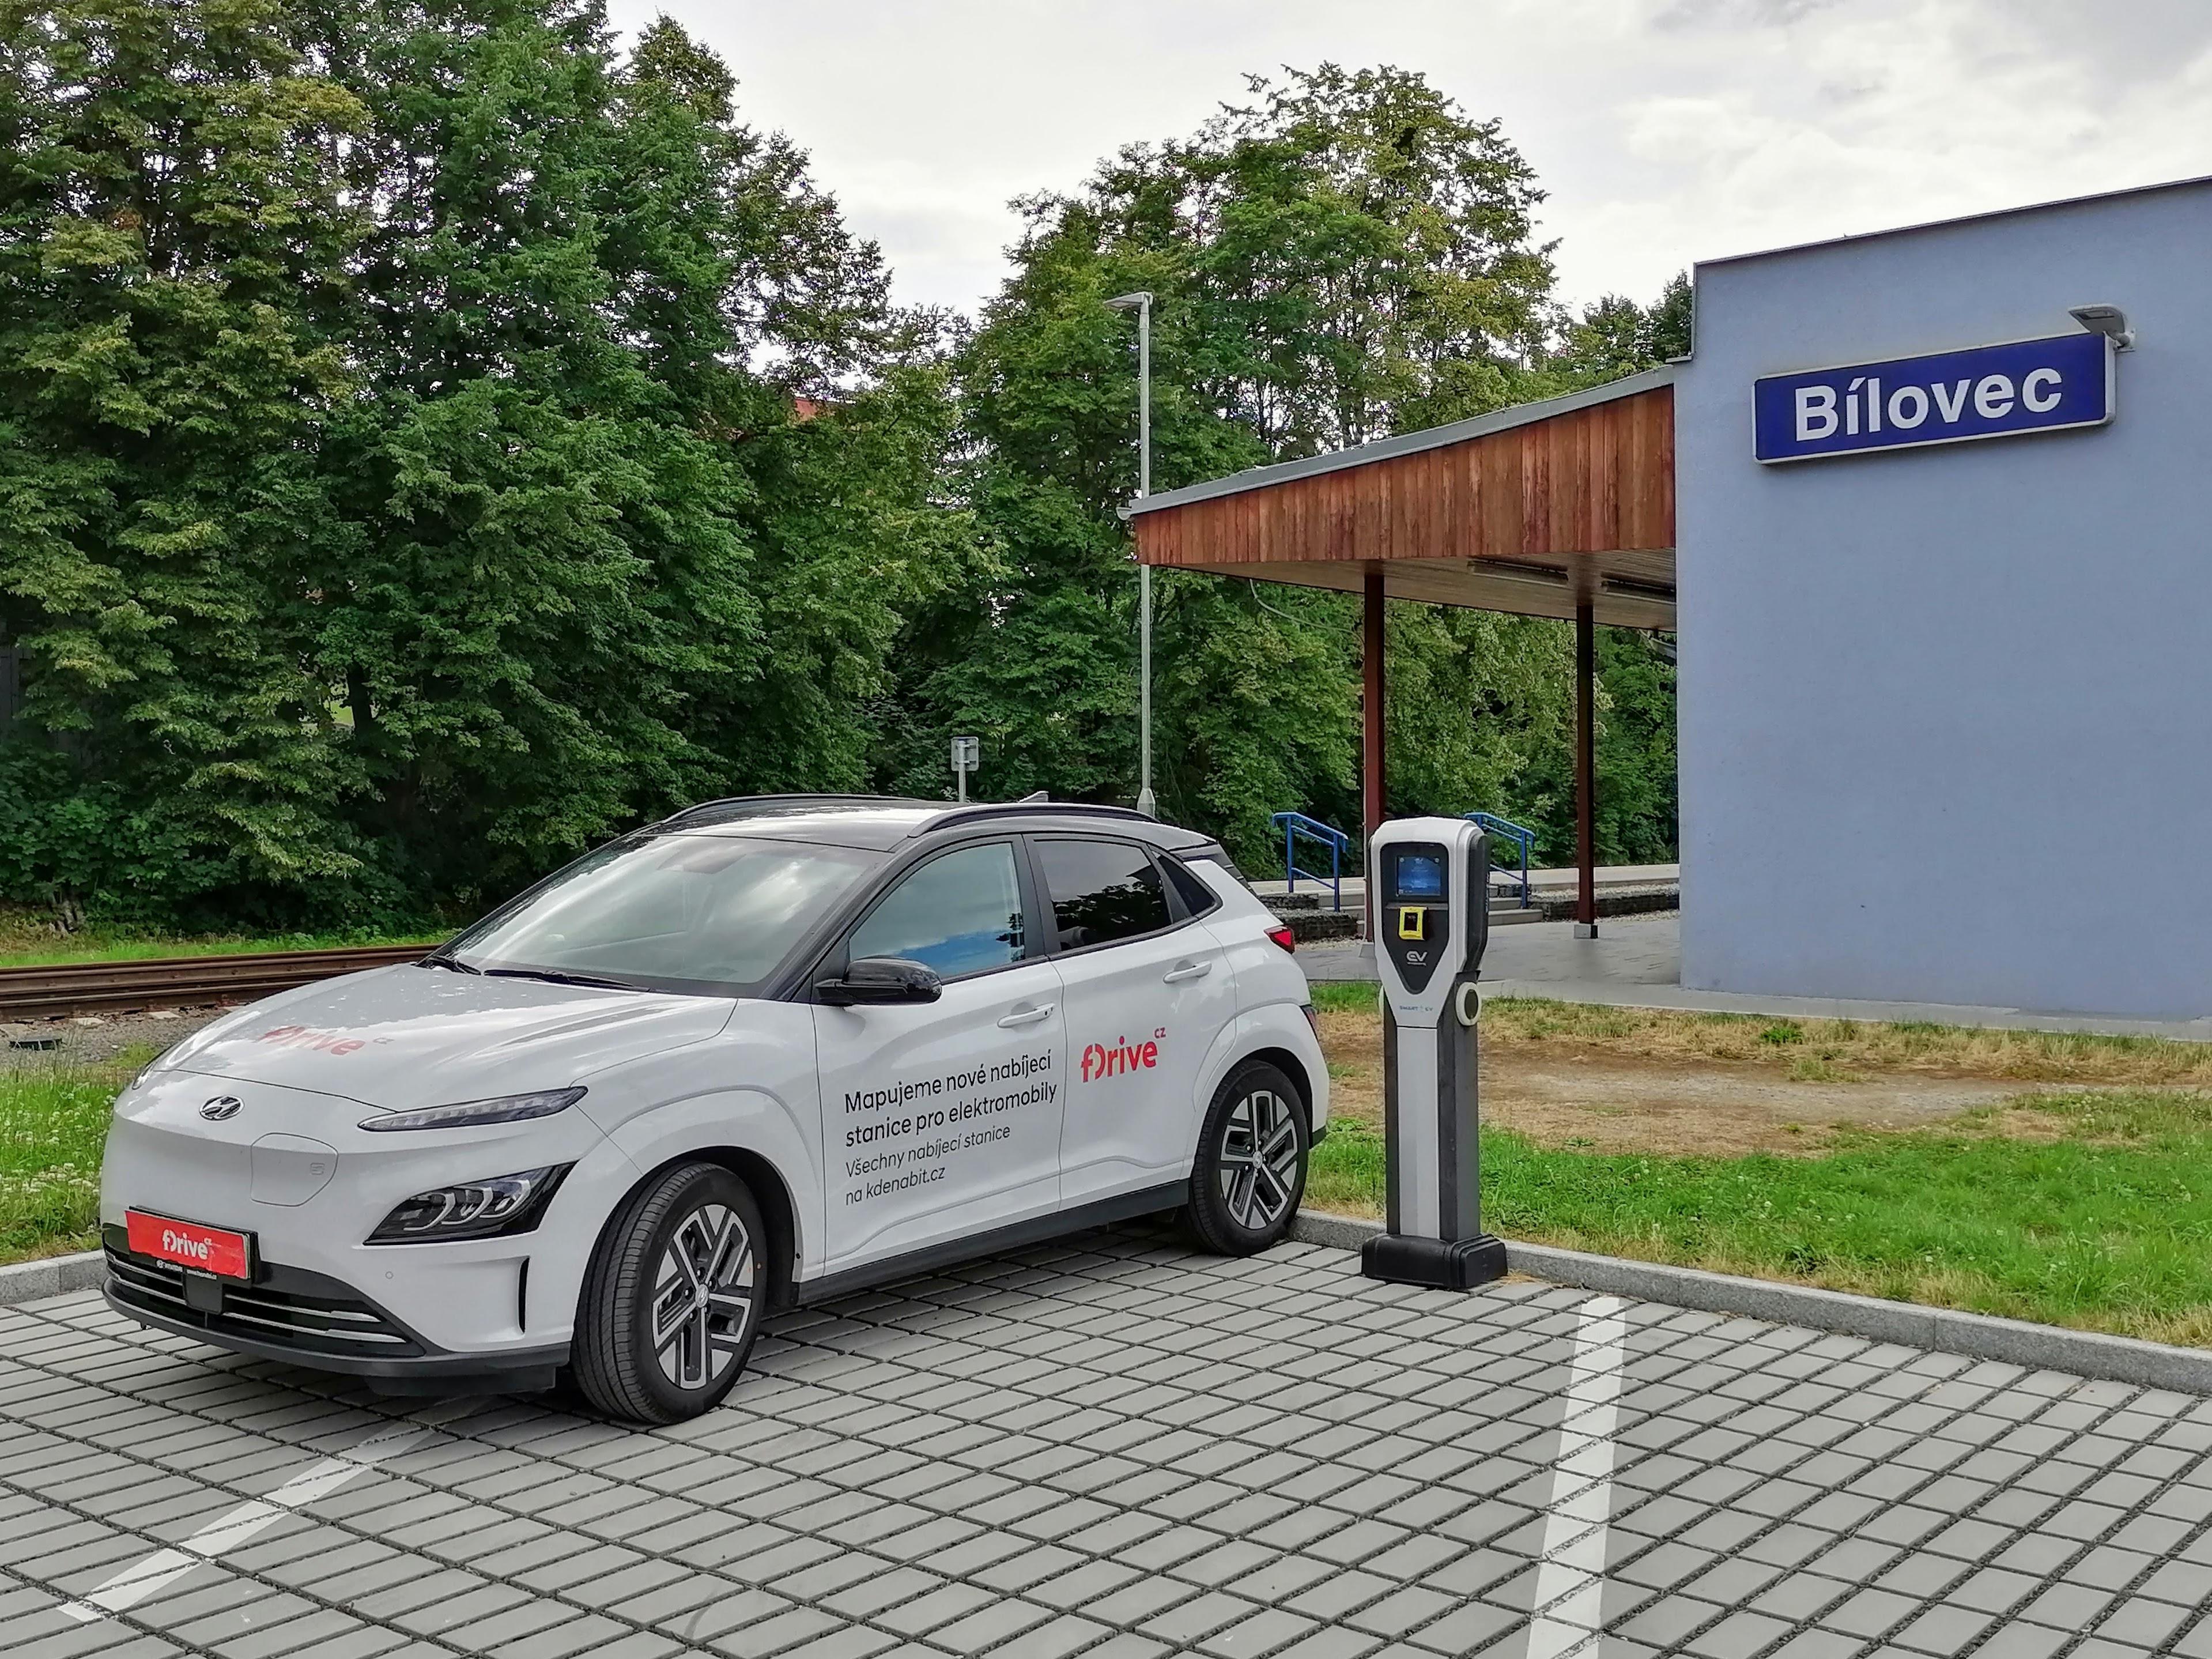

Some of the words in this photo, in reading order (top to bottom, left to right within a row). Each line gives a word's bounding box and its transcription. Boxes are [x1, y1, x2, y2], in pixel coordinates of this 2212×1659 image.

[1795, 368, 2063, 441] Bílovec
[845, 1079, 942, 1113] Mapujeme
[946, 1064, 986, 1091] nové
[990, 1049, 1051, 1082] nabíjecí
[845, 1117, 912, 1147] stanice
[916, 1110, 945, 1135] pro
[949, 1081, 1057, 1122] elektromobily
[846, 1152, 904, 1178] Všechny
[908, 1133, 962, 1162] nabíjecí
[964, 1125, 1010, 1148] stanice
[845, 1189, 862, 1205] na
[866, 1166, 945, 1199] kdenabit.cz
